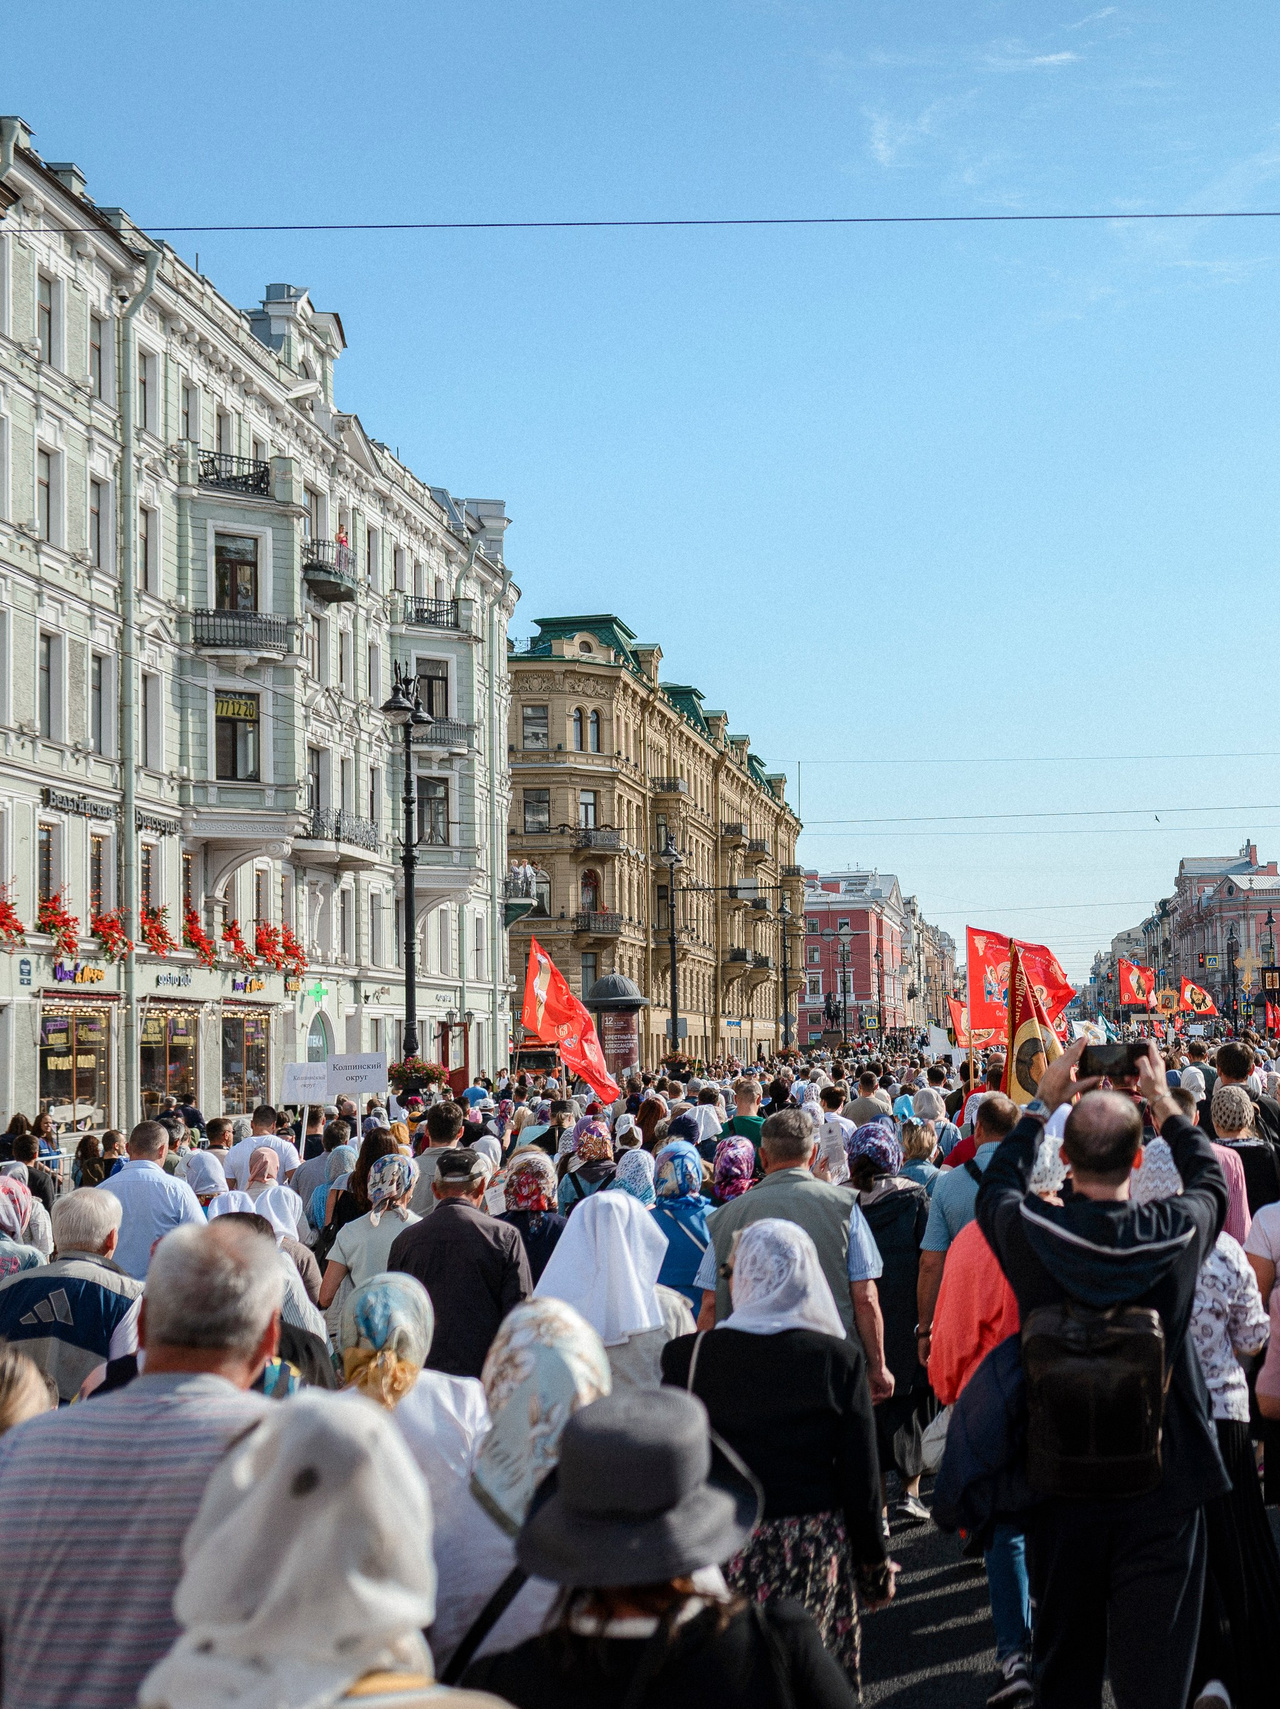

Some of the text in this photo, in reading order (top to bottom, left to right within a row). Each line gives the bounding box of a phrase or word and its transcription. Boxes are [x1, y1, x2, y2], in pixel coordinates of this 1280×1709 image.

[231, 700, 241, 716] 12
[243, 701, 254, 718] 20
[49, 789, 113, 818] Бельгийская
[135, 807, 180, 833] Брассерия
[332, 1062, 382, 1072] Колпинский
[345, 1073, 369, 1083] округ
